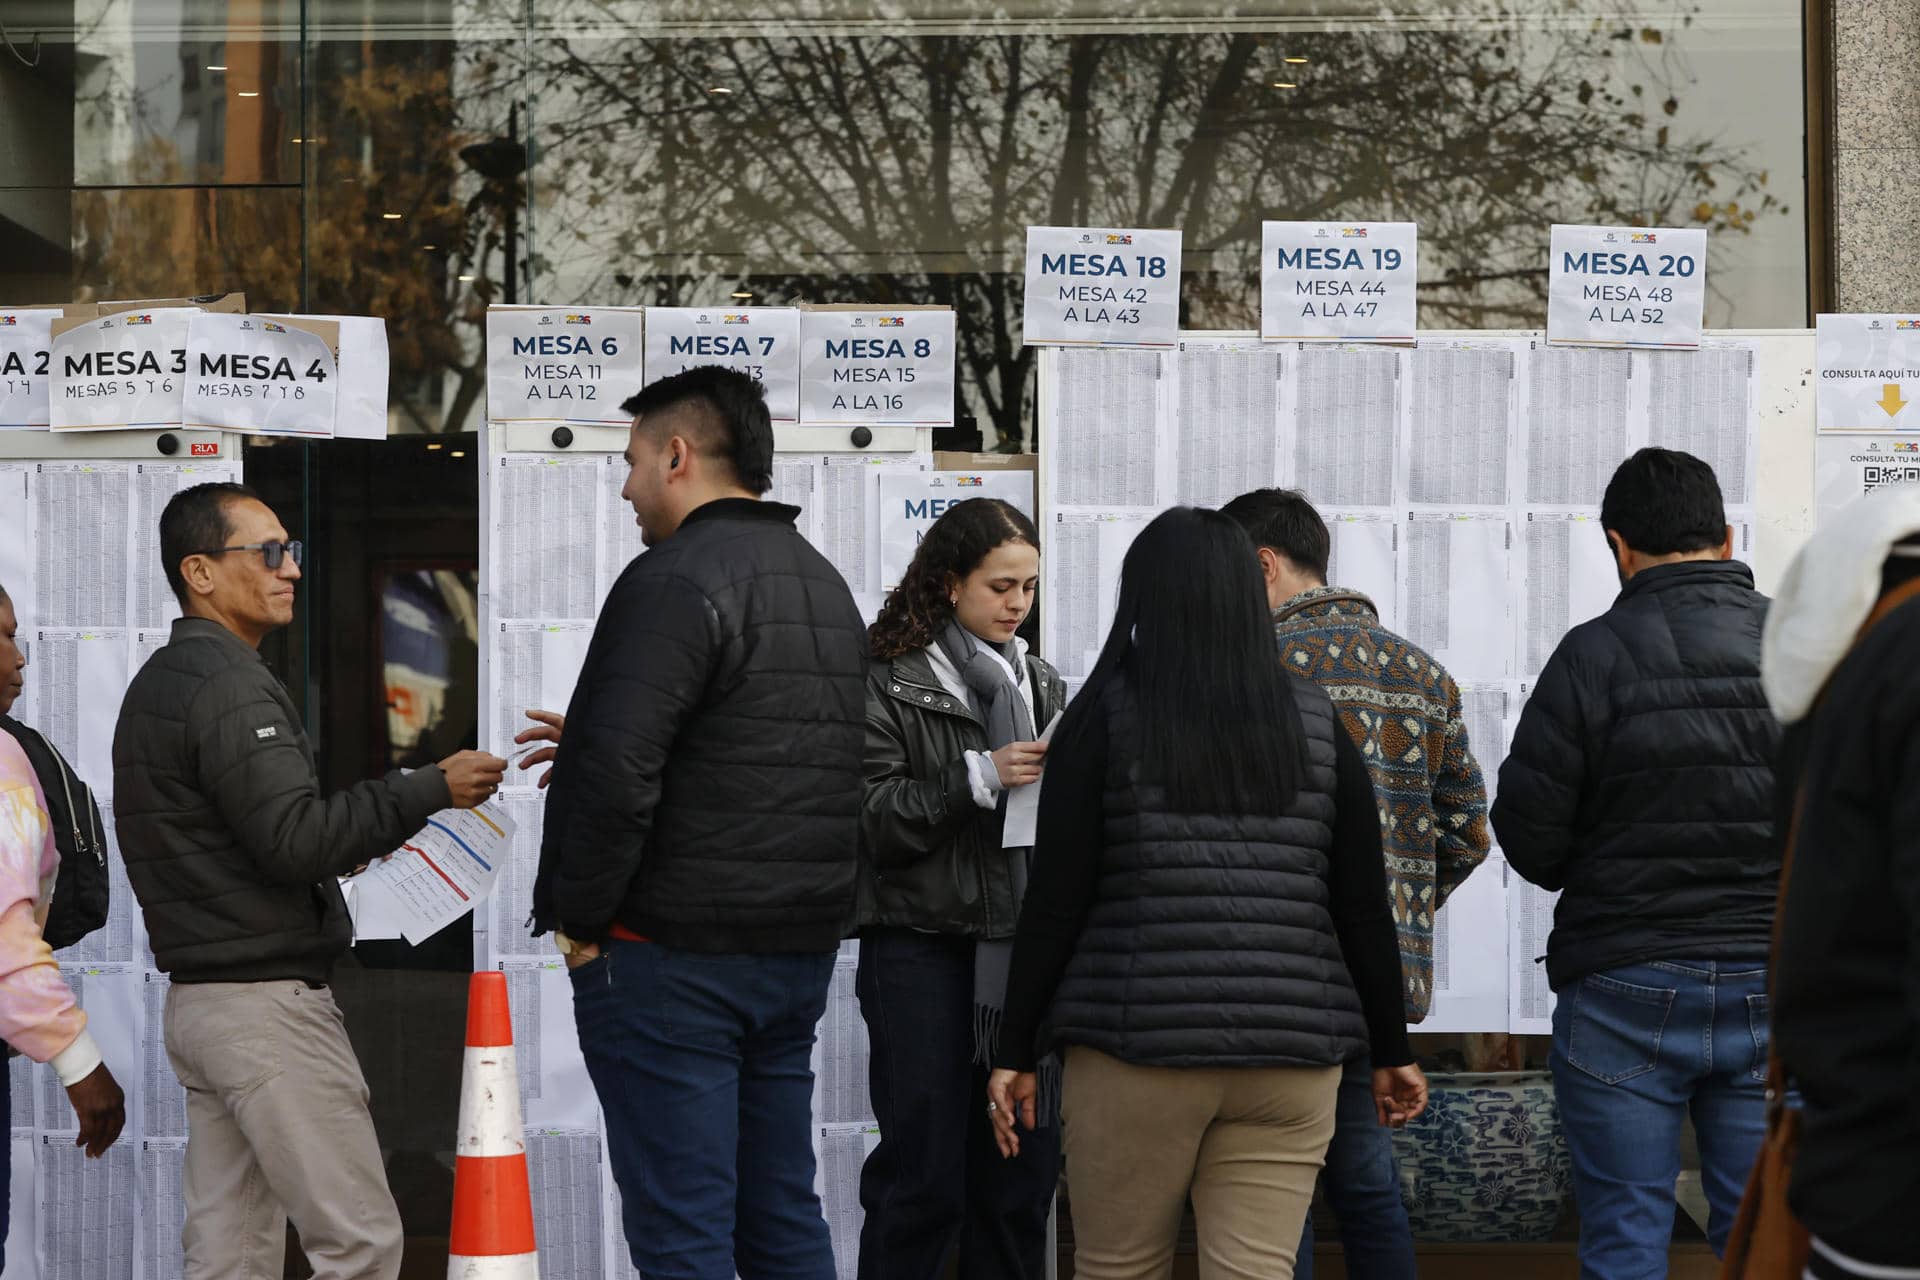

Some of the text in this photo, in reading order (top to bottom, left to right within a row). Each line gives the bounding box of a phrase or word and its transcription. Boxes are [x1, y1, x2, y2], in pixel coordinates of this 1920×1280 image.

[1041, 253, 1167, 278] MESA 18
[1278, 248, 1402, 270] MESA 19
[1563, 252, 1695, 277] MESA 20
[1059, 286, 1147, 304] MESA 42
[1296, 280, 1386, 296] MESA 44
[1583, 285, 1673, 303] MESA 48
[1064, 307, 1140, 324] A LA 43
[1302, 302, 1378, 317] A LA 47
[1588, 306, 1664, 324] A LA 52
[513, 336, 618, 356] MESA 6
[670, 336, 775, 356] MESA 7
[826, 338, 931, 358] MESA 8
[34, 351, 50, 375] 2
[65, 349, 187, 377] MESA 3
[200, 352, 327, 382] MESA 4
[525, 365, 601, 380] MESA 11
[833, 368, 915, 382] MESA 15
[1822, 367, 1920, 381] CONSULTA AQUÍ TU
[21, 380, 30, 395] 4
[66, 381, 118, 398] MESAS
[126, 381, 136, 395] 5
[163, 378, 173, 392] 6
[198, 383, 253, 398] MESAS
[262, 385, 270, 399] 7
[294, 386, 305, 400] 8
[527, 385, 596, 400] A LA 12
[832, 395, 903, 409] A LA 16
[1850, 455, 1895, 463] CONSULTA
